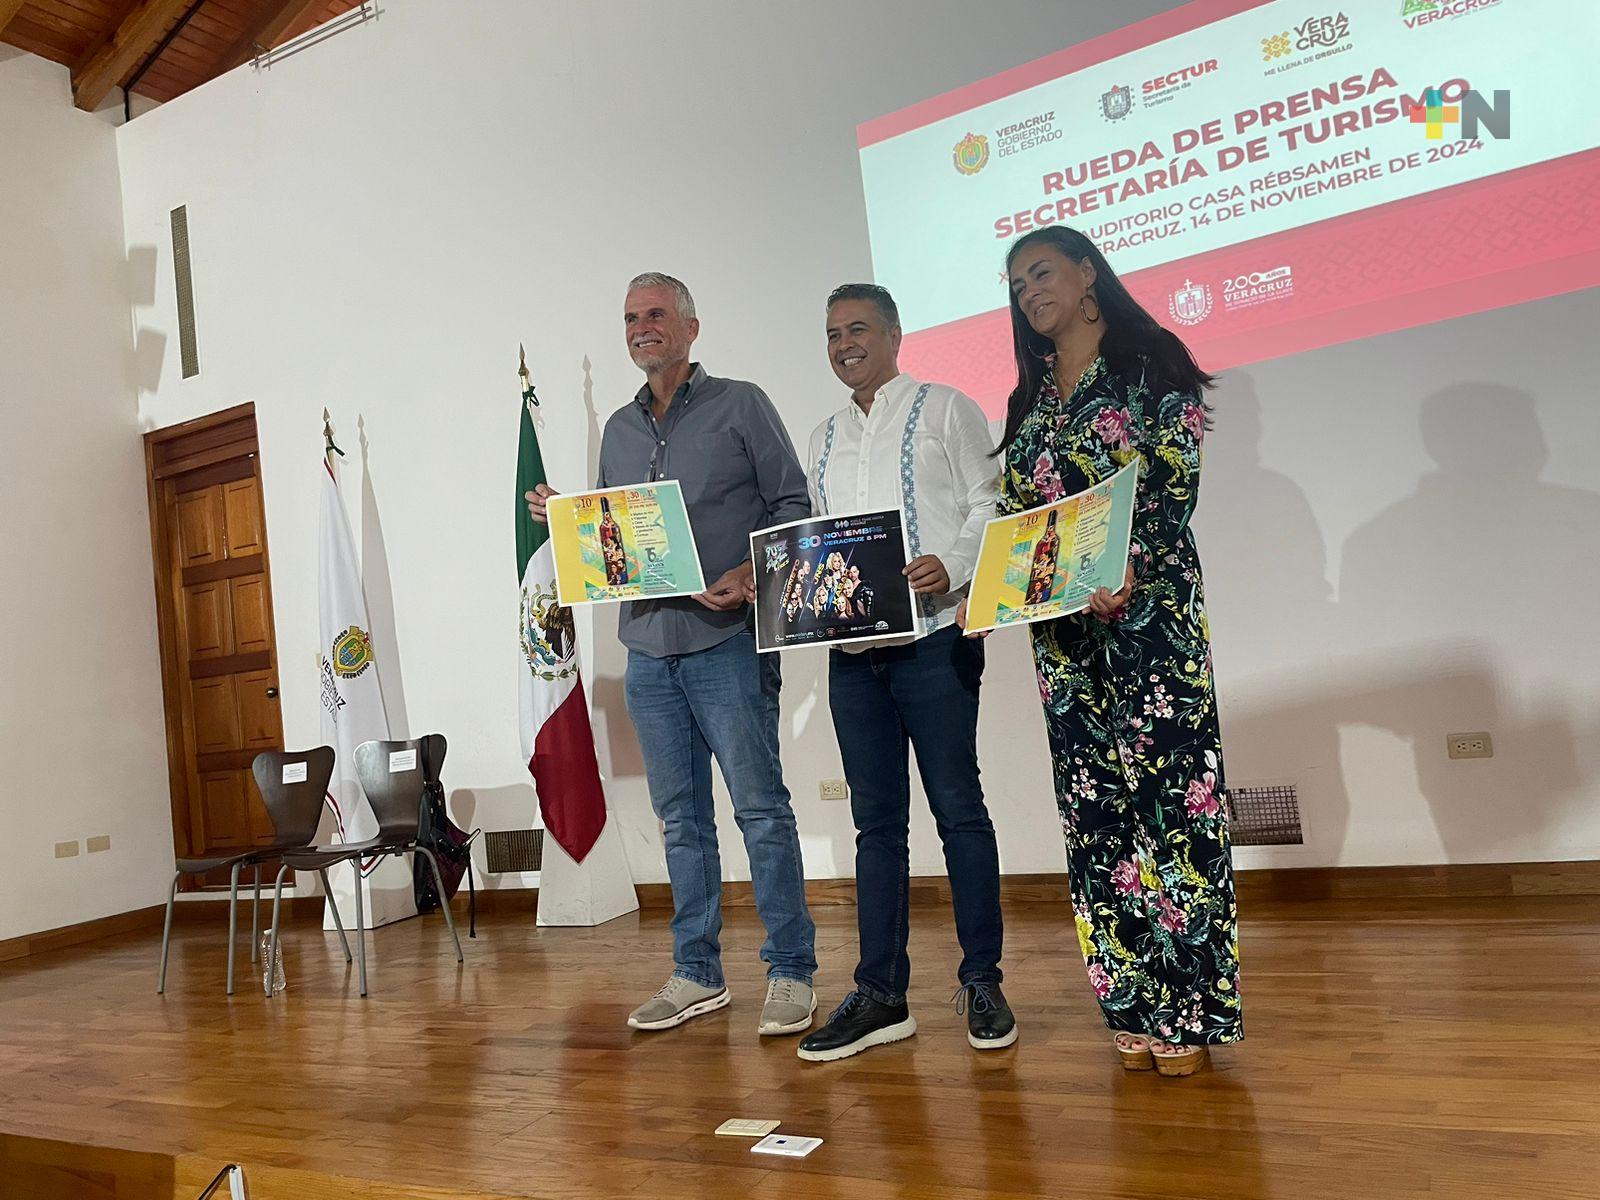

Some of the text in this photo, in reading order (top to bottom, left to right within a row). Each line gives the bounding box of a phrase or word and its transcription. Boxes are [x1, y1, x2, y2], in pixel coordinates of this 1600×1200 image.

[1294, 11, 1349, 37] VERA
[1403, 0, 1501, 29] VERACRU
[1296, 23, 1350, 50] CRUZ
[1277, 60, 1302, 73] LLENA
[1303, 56, 1314, 64] DE
[1315, 43, 1353, 60] ORGULLO
[1142, 59, 1218, 94] SECTUR
[1143, 95, 1174, 109] Turismo
[996, 111, 1055, 138] VERACRUZ
[997, 122, 1052, 148] GOBIERNO
[1042, 67, 1399, 196] RUEDA DE PRENSA
[998, 129, 1063, 158] DEL ESTADO
[993, 77, 1471, 240] SECRETARÍA DE TURISMO
[1189, 185, 1246, 211] CASA
[1250, 147, 1371, 194] RÉBSAMEN
[1190, 213, 1212, 230] 14
[1216, 202, 1246, 223] DE
[1250, 164, 1383, 213] NOVIEMBRE
[1389, 152, 1422, 174] DE
[1426, 136, 1485, 164] 2024
[1222, 272, 1261, 293] 200
[1223, 278, 1294, 302] VERACRUZ
[798, 527, 883, 550] 30 NOVIEMBRE
